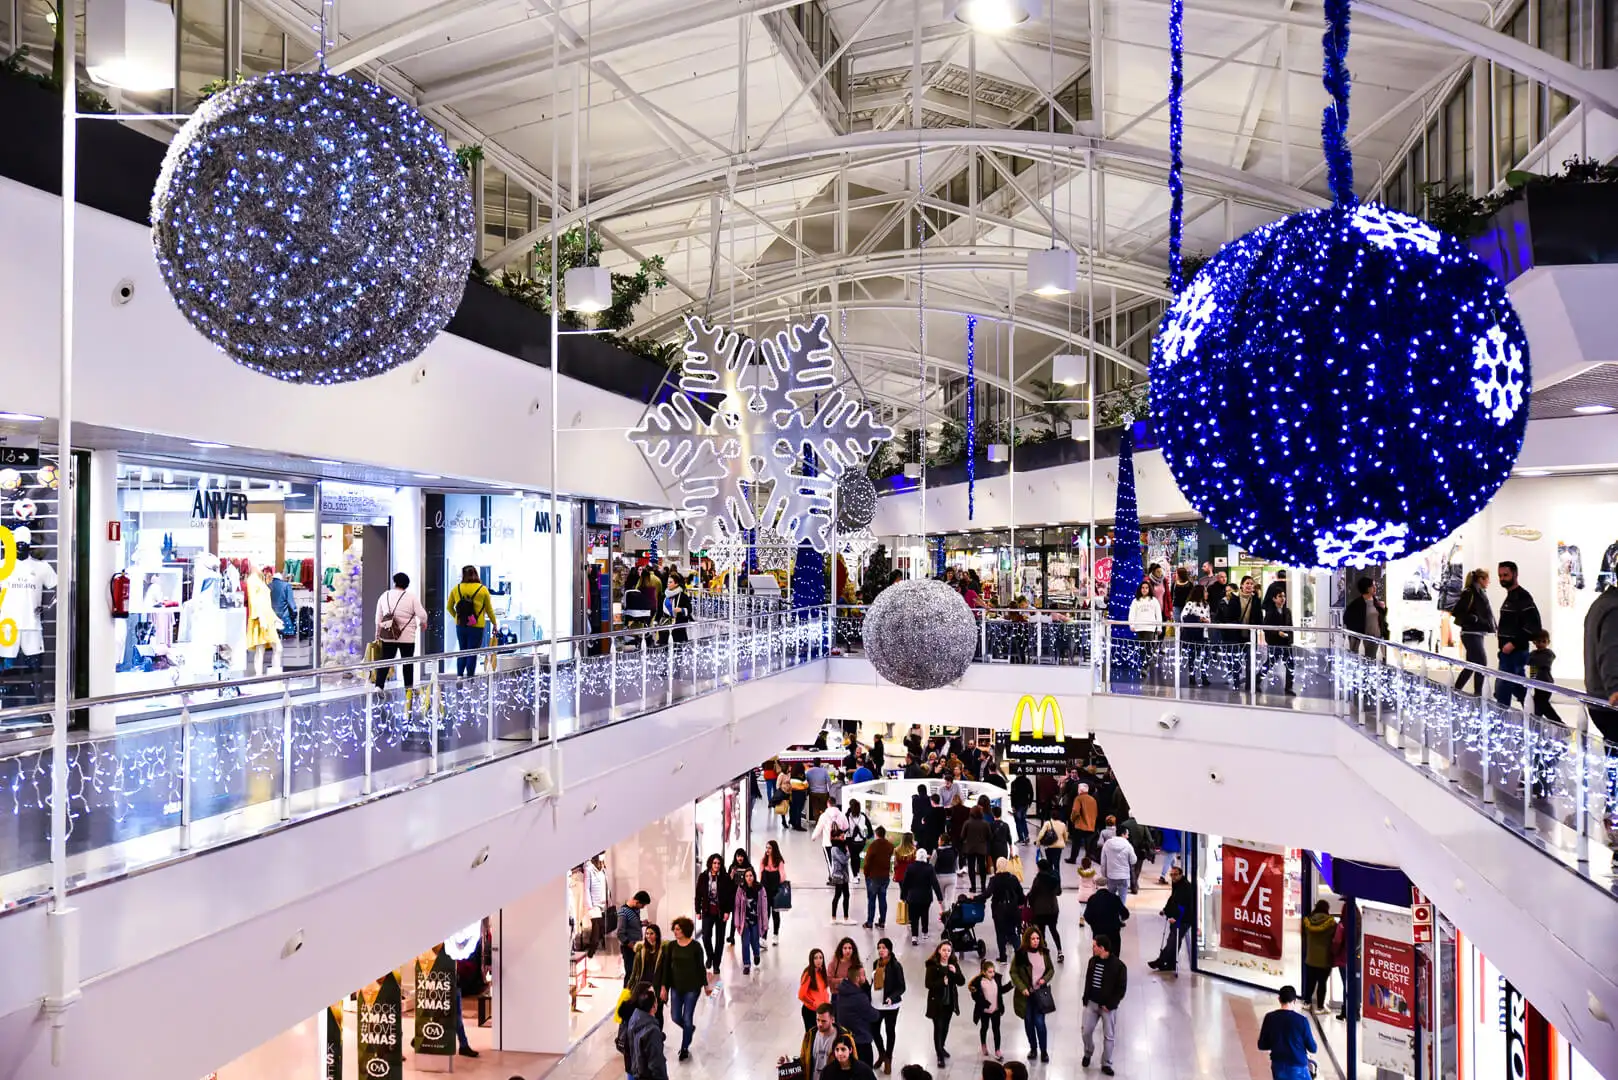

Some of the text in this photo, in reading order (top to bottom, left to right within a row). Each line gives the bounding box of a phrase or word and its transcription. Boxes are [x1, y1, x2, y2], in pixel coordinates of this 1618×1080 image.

[192, 489, 248, 521] ANVER
[1010, 743, 1065, 754] McDonald's
[1233, 907, 1273, 928] BAJAS
[1369, 957, 1410, 975] A PRECIO
[1369, 967, 1410, 985] DE COSTE
[417, 980, 451, 991] XMAS
[417, 990, 451, 1000] #LOVE
[417, 999, 451, 1011] XMAS
[361, 1012, 396, 1024] XMAS
[361, 1023, 396, 1035] #LOVE
[361, 1033, 396, 1045] XMAS
